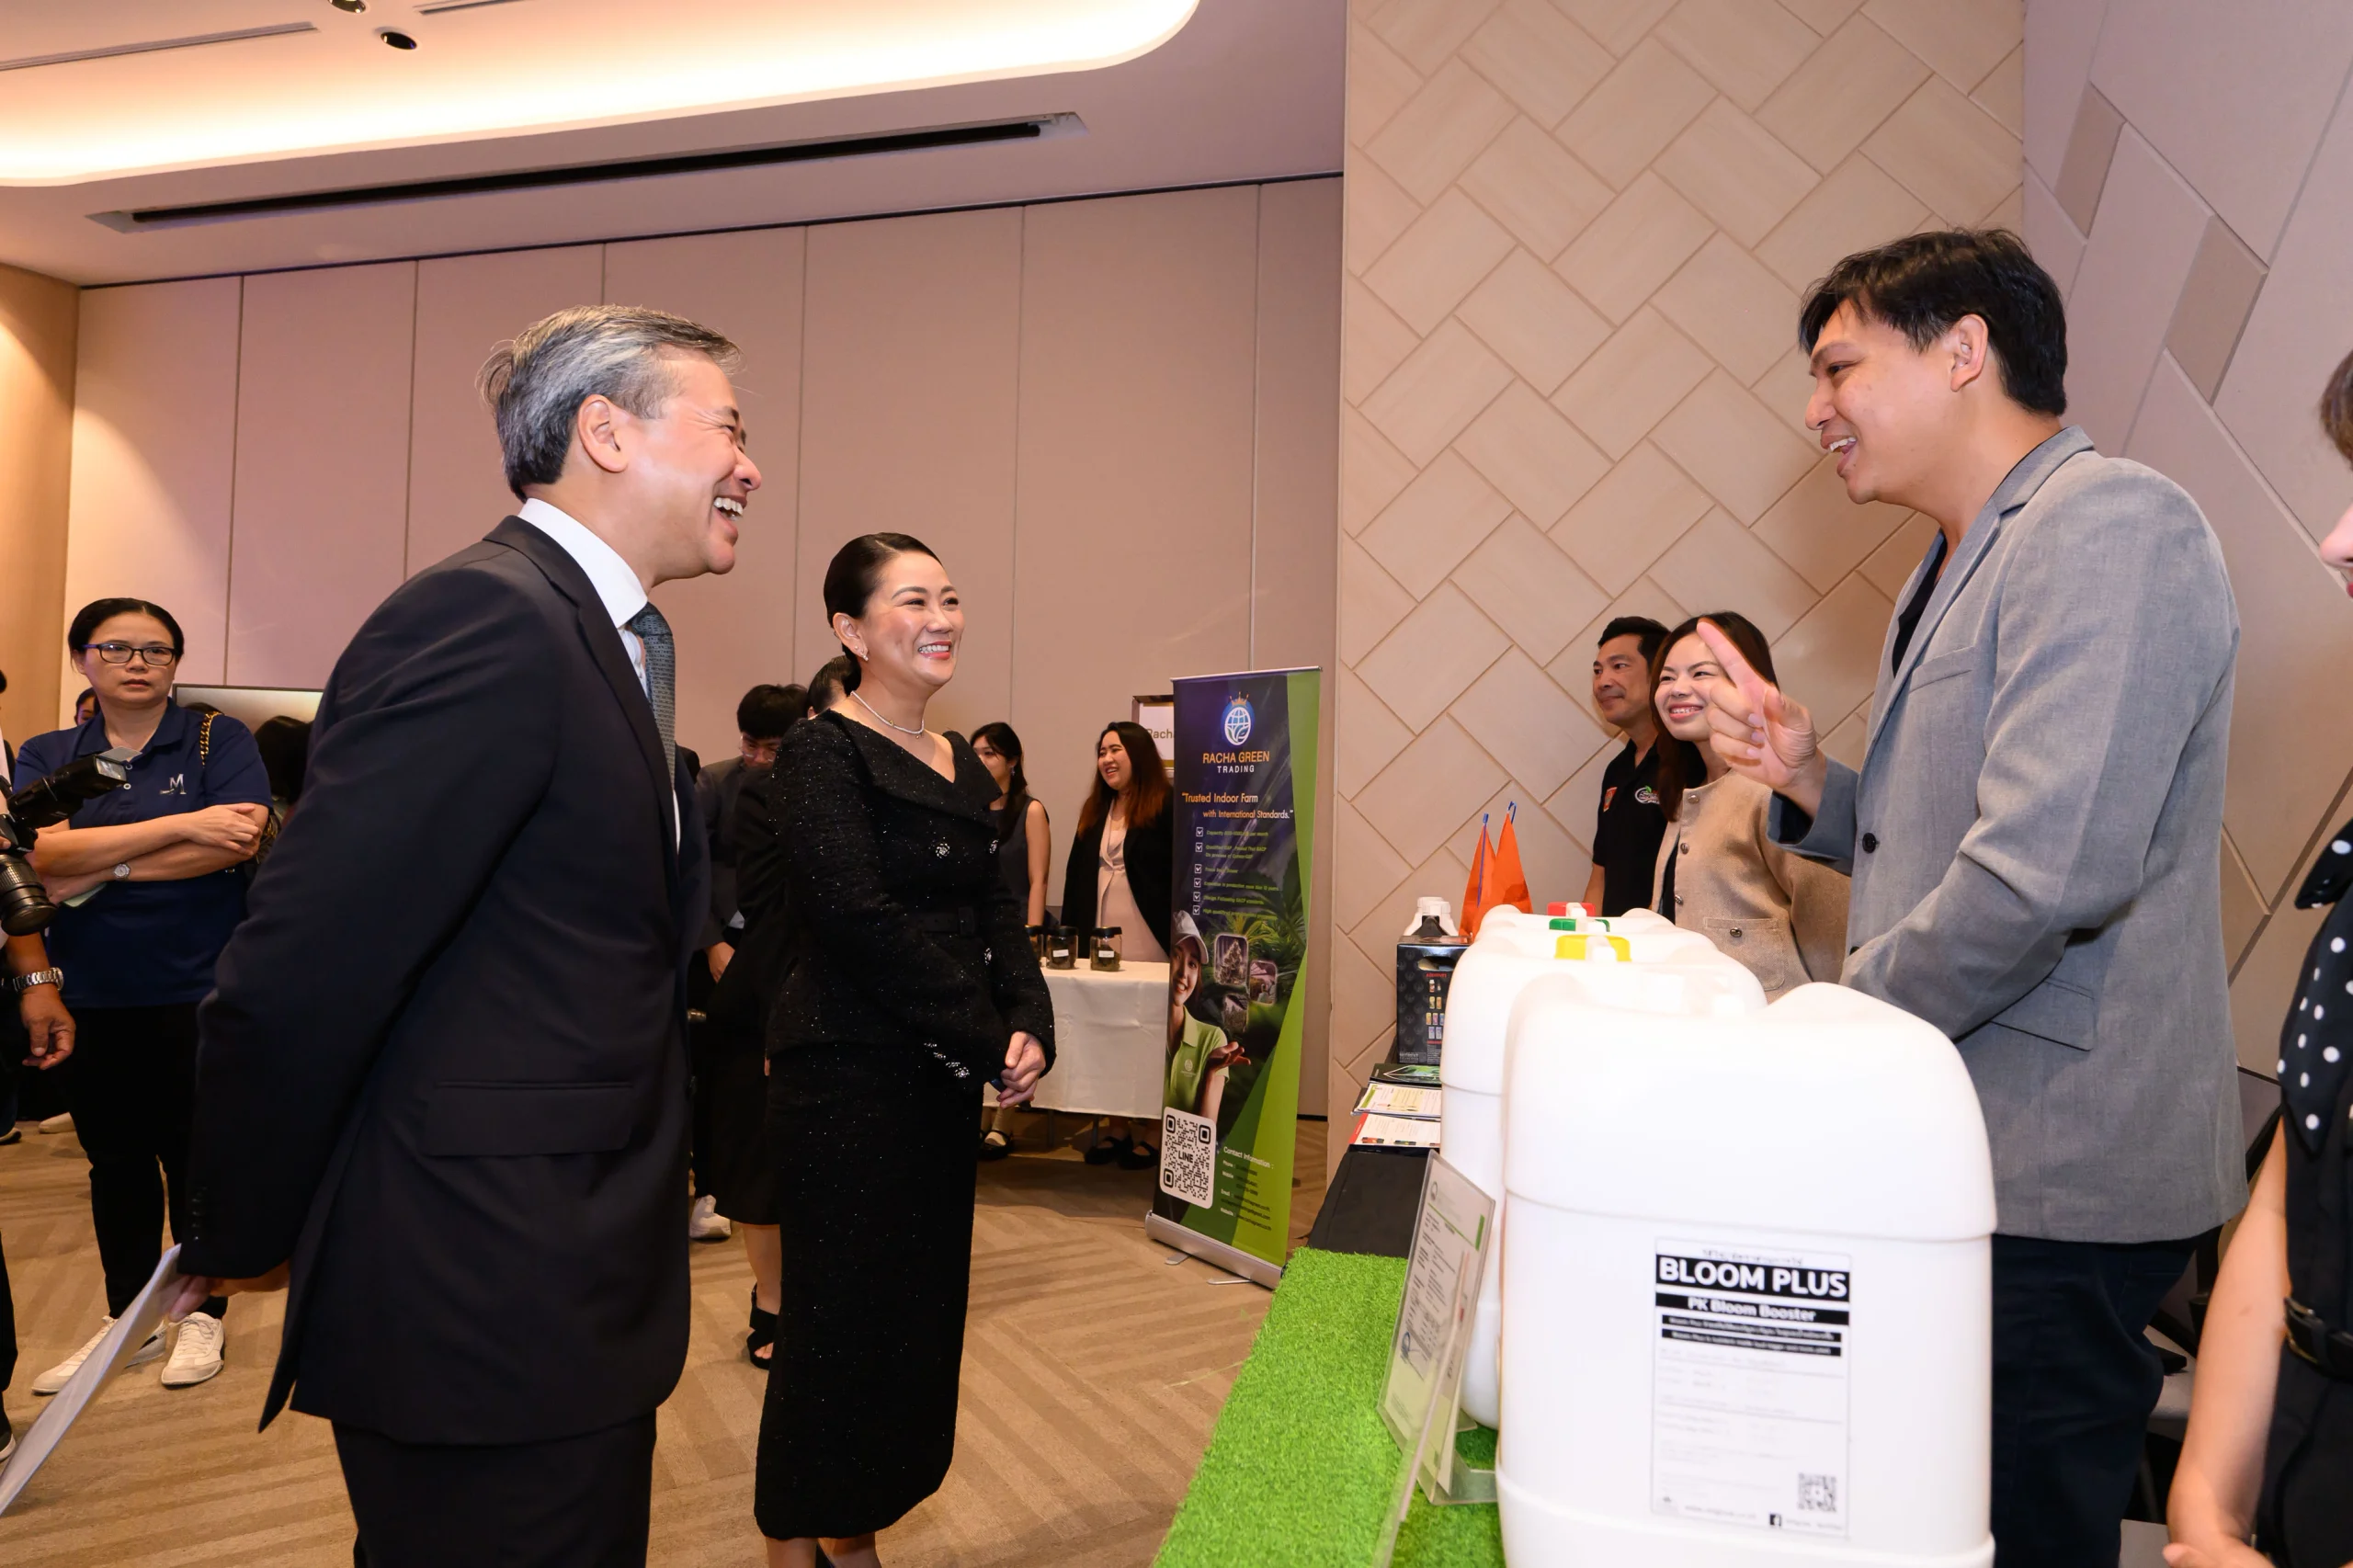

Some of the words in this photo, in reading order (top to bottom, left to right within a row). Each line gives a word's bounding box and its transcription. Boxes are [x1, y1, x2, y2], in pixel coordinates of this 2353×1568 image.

[1147, 728, 1174, 739] Rach
[1202, 751, 1236, 764] RACHA
[1238, 750, 1270, 763] GREEN
[1217, 765, 1255, 774] TRADING
[1213, 792, 1239, 803] Indoor
[1240, 792, 1258, 803] Farm
[1202, 809, 1216, 818] with
[1218, 810, 1256, 819] International
[1178, 1150, 1193, 1164] LINE
[1223, 1146, 1243, 1159] Contact
[1243, 1153, 1270, 1168] Information
[1658, 1256, 1766, 1291] BLOOM
[1772, 1267, 1848, 1298] PLUS
[1688, 1296, 1710, 1312] PK
[1711, 1299, 1757, 1317] Bloom
[1758, 1304, 1817, 1322] Booster
